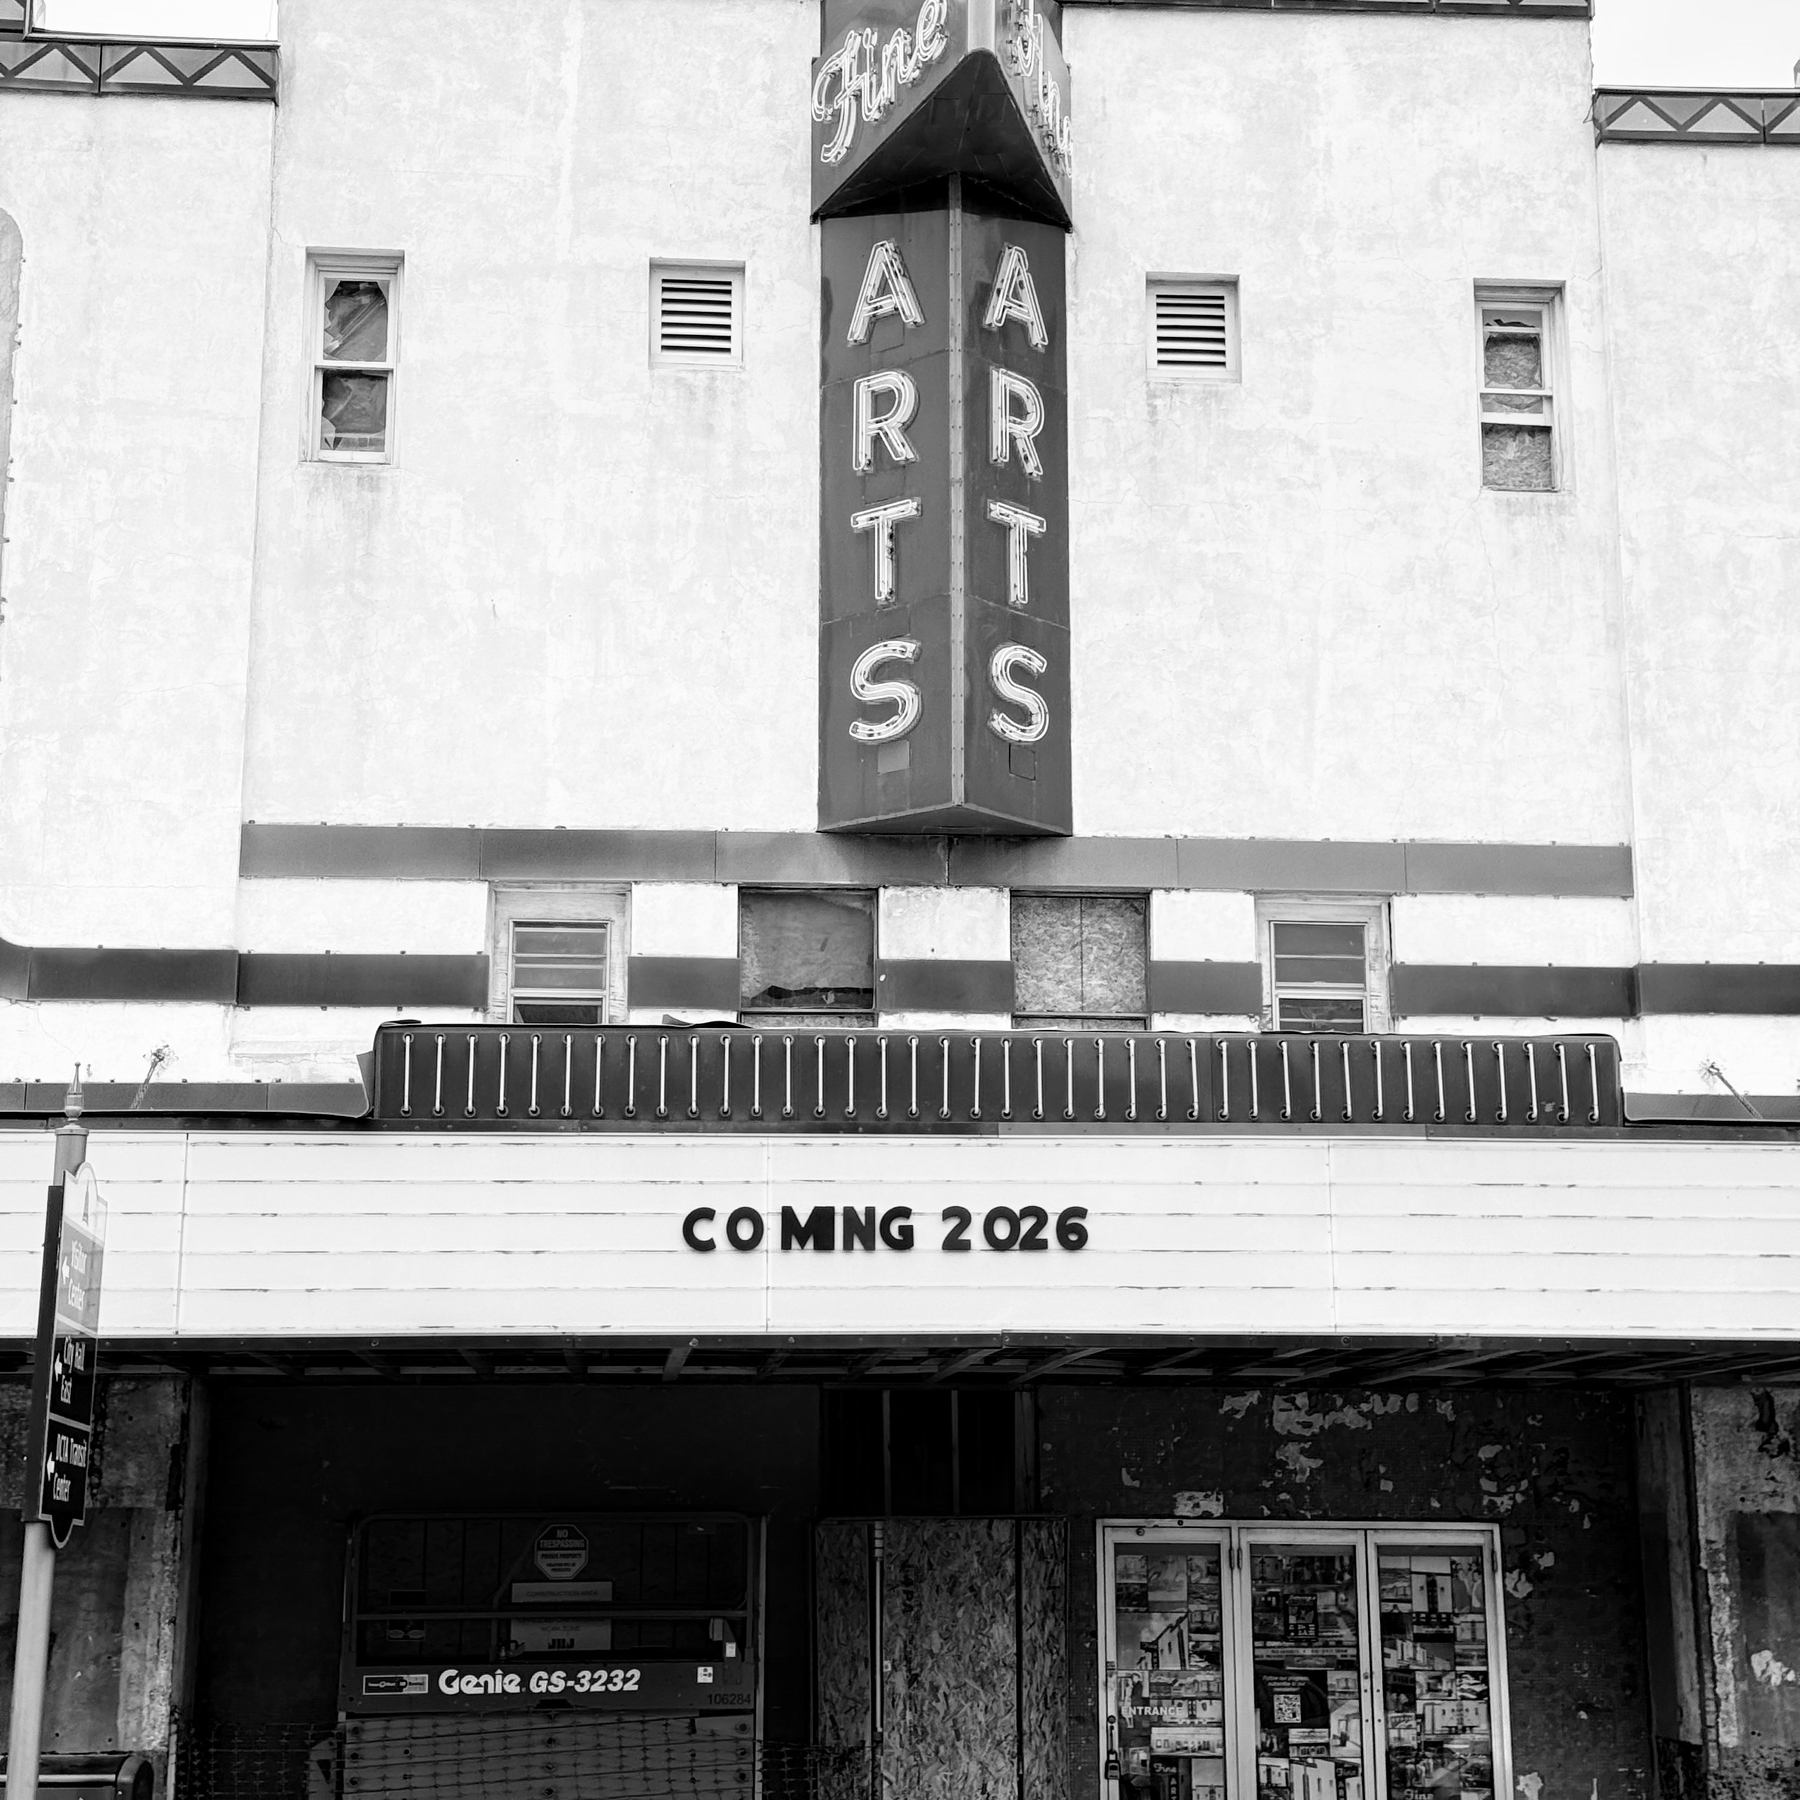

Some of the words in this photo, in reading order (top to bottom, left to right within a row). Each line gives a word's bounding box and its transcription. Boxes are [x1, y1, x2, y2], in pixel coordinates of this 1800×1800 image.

[811, 0, 948, 163] Fine
[847, 240, 926, 746] ARTS
[983, 241, 1050, 745] ARTS
[682, 1205, 914, 1252] COMING
[941, 1205, 1088, 1251] 2026
[71, 1240, 88, 1275] Visitor
[68, 1278, 86, 1312] Center
[63, 1335, 75, 1374] City
[60, 1374, 73, 1405] East
[55, 1432, 69, 1464] DCTA
[69, 1437, 87, 1468] Transit
[53, 1472, 72, 1503] Center
[539, 1539, 585, 1549] TRESPASSING
[556, 1529, 569, 1538] NO
[438, 1668, 522, 1695] Genie
[529, 1668, 642, 1693] GS-3232
[707, 1693, 751, 1705] 106284
[1121, 1706, 1184, 1717] ENTRANCE
